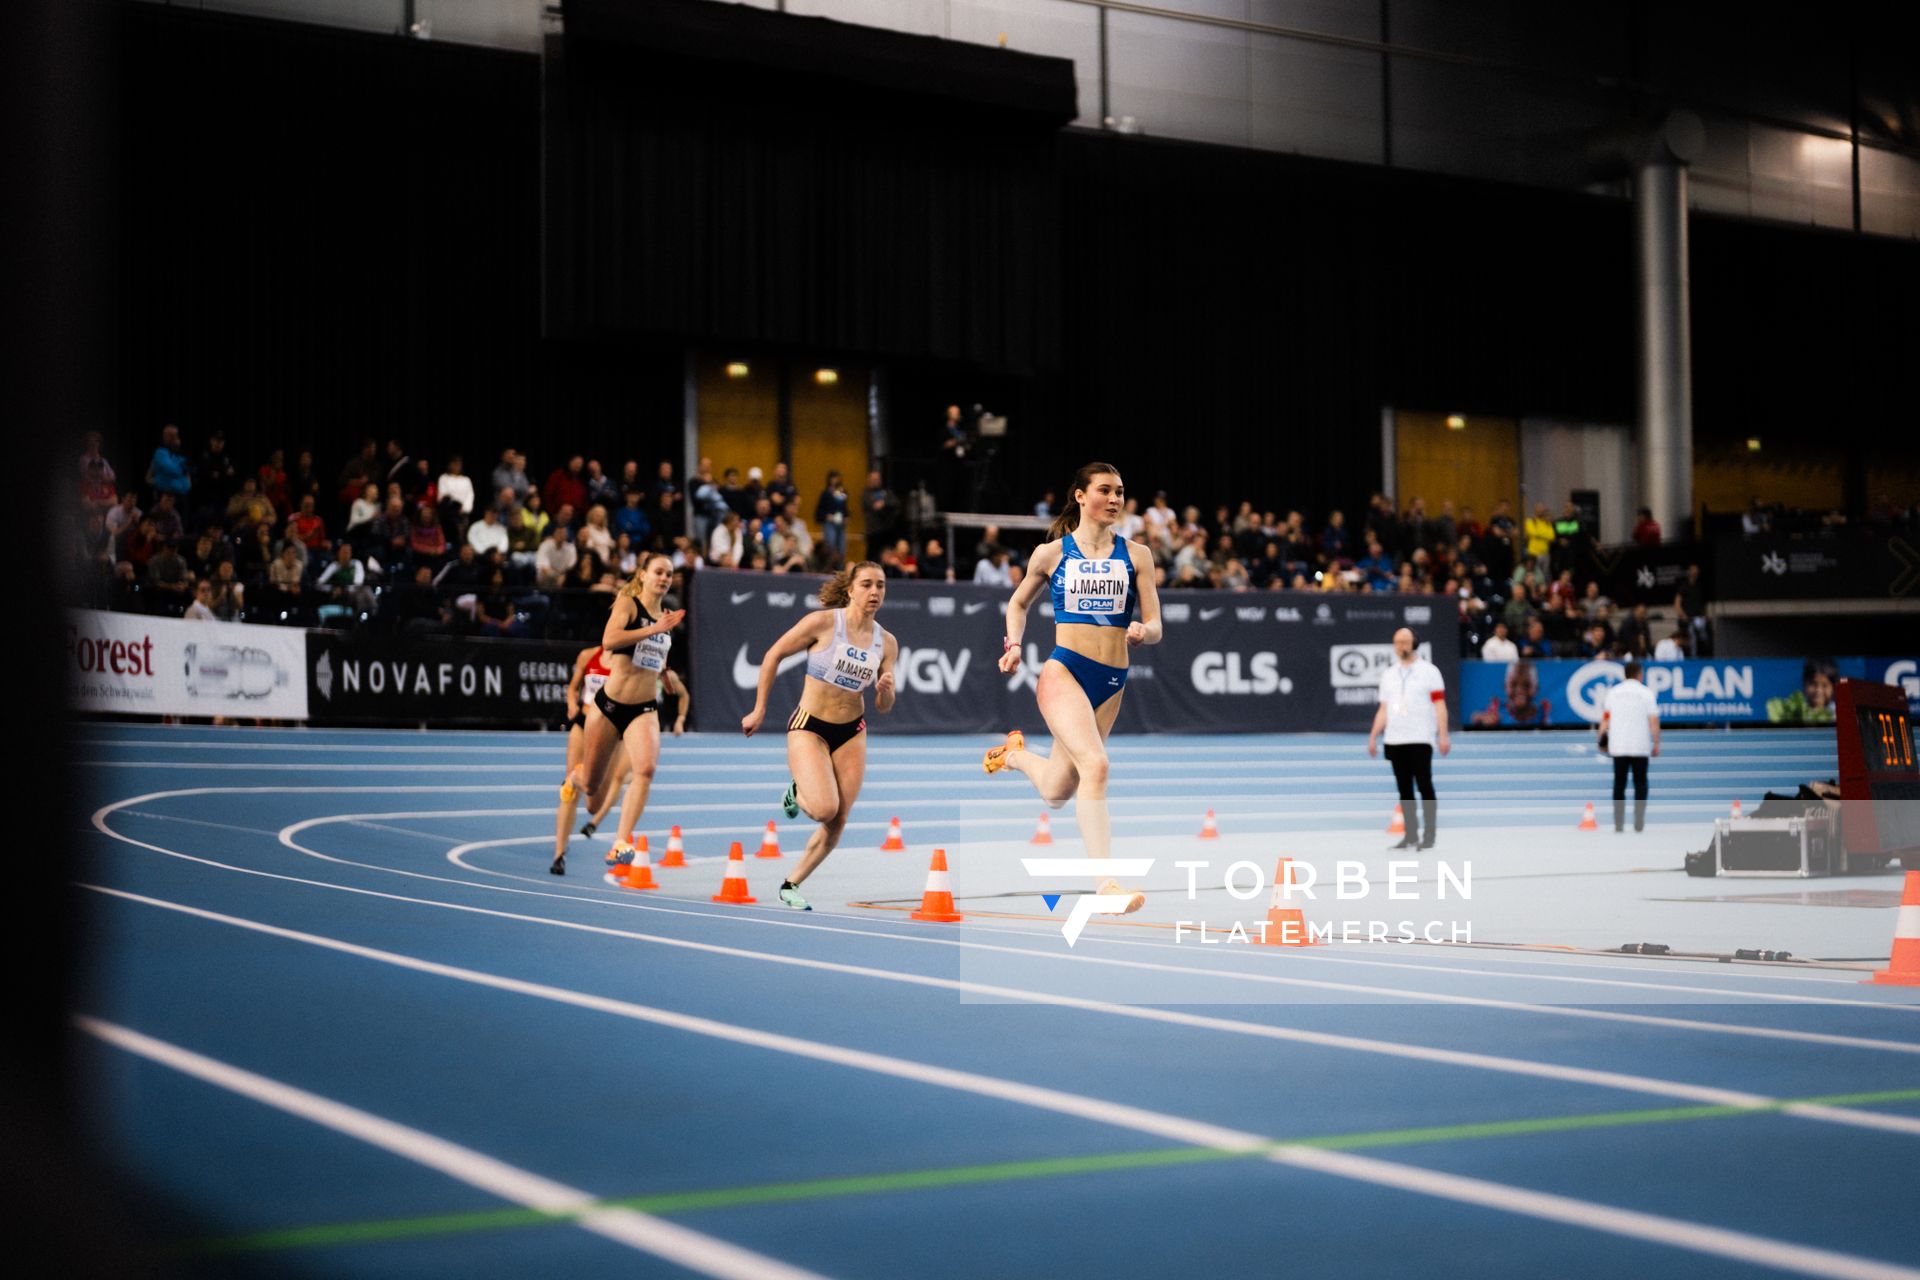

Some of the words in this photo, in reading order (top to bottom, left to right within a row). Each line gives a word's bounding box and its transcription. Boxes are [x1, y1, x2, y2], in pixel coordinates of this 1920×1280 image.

[1079, 561, 1111, 574] GLS
[1070, 579, 1124, 596] J.MARTIN
[1092, 600, 1113, 608] PLAN
[846, 647, 868, 662] GLS
[342, 659, 502, 697] NOVAFON
[518, 661, 569, 683] GEGEN
[835, 658, 874, 681] M.MAYER
[1190, 651, 1294, 695] GLS.
[1645, 665, 1754, 701] PLAN
